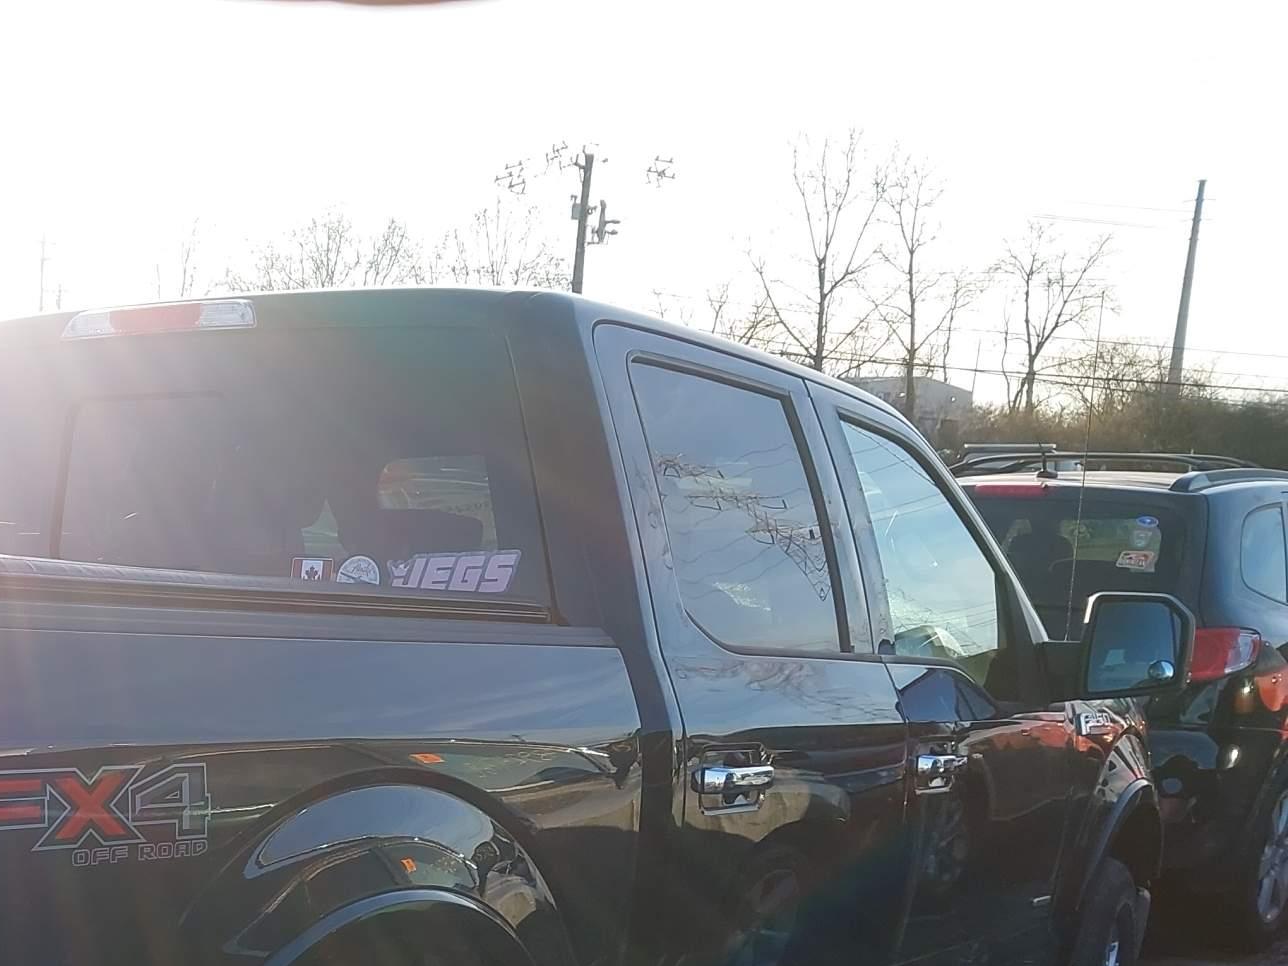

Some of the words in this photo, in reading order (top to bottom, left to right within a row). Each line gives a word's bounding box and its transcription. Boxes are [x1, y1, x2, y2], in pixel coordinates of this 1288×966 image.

[391, 554, 514, 593] JEGS
[72, 844, 129, 867] OFF
[138, 839, 208, 861] ROAD
